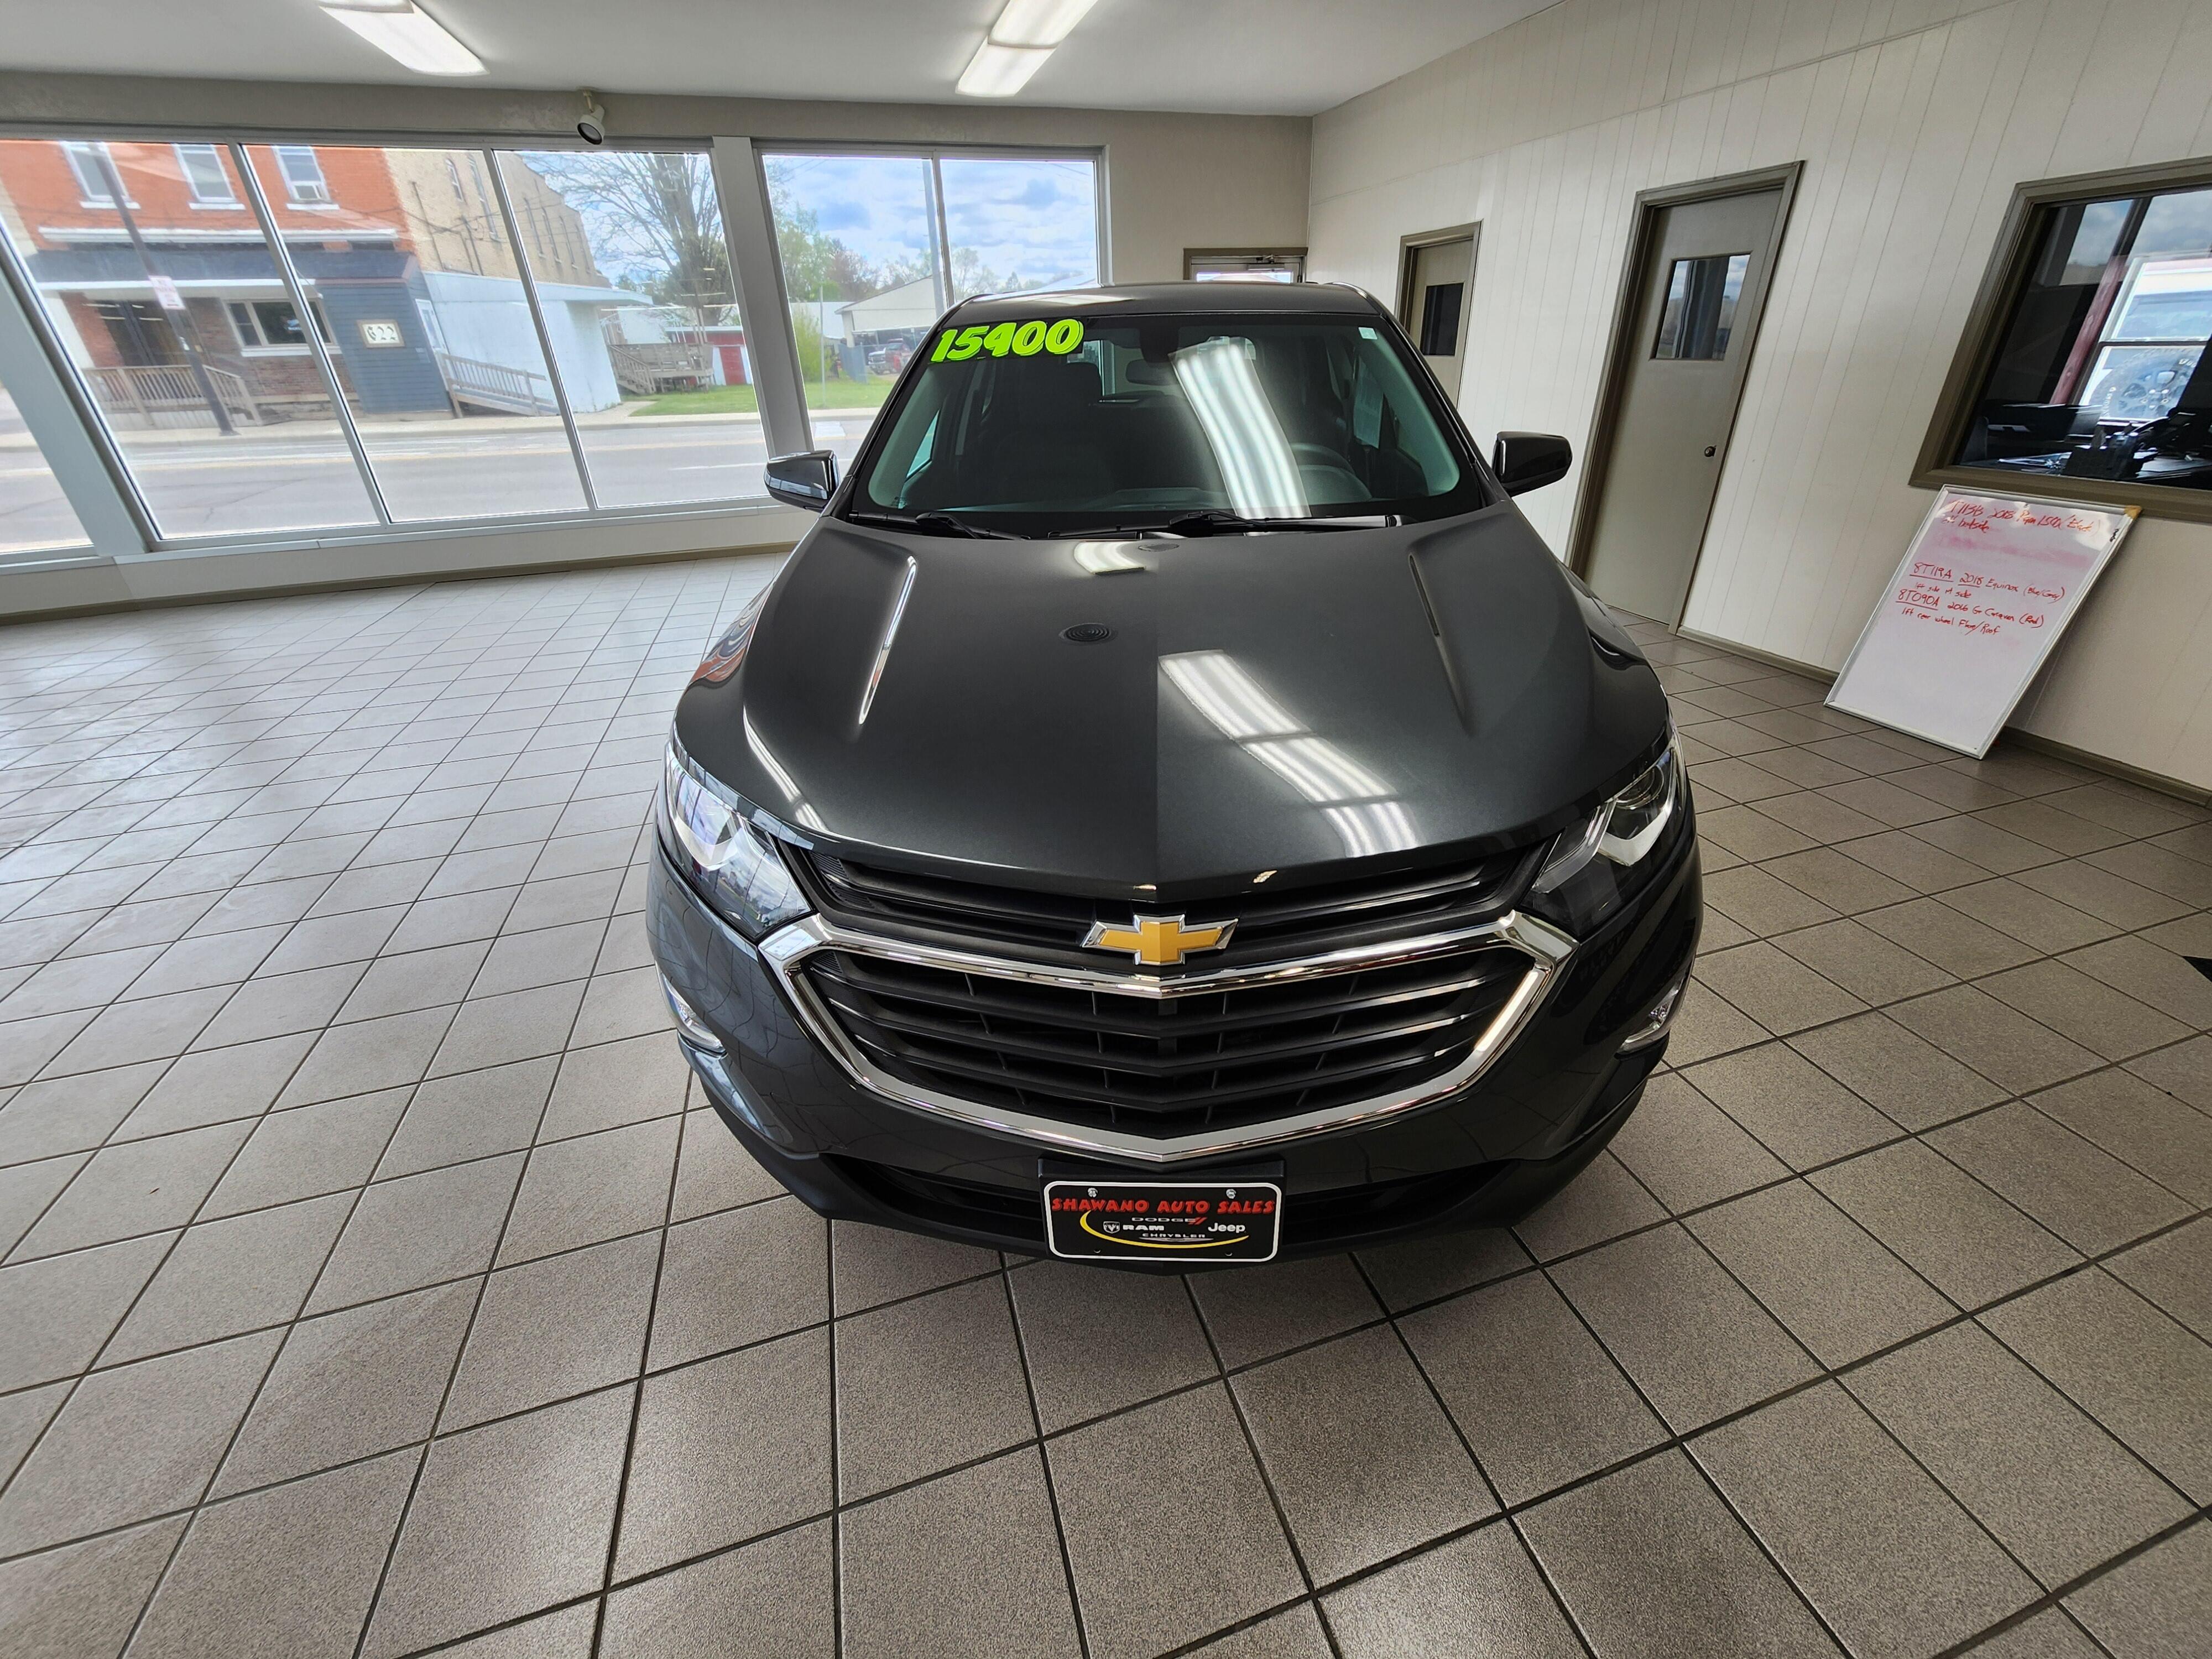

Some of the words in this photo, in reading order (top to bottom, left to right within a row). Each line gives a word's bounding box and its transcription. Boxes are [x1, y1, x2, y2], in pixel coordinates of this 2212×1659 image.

[367, 326, 397, 341] 622
[931, 319, 1084, 362] 15400
[1960, 572, 1984, 585] 2018
[1985, 578, 2018, 592] Equinox
[1947, 602, 1969, 611] 2016
[1934, 616, 1954, 625] wheel
[1052, 1198, 1150, 1213] SHAWANO
[1157, 1200, 1210, 1214] AUTO
[1217, 1200, 1275, 1214] SALES
[1208, 1222, 1245, 1233] Jeep
